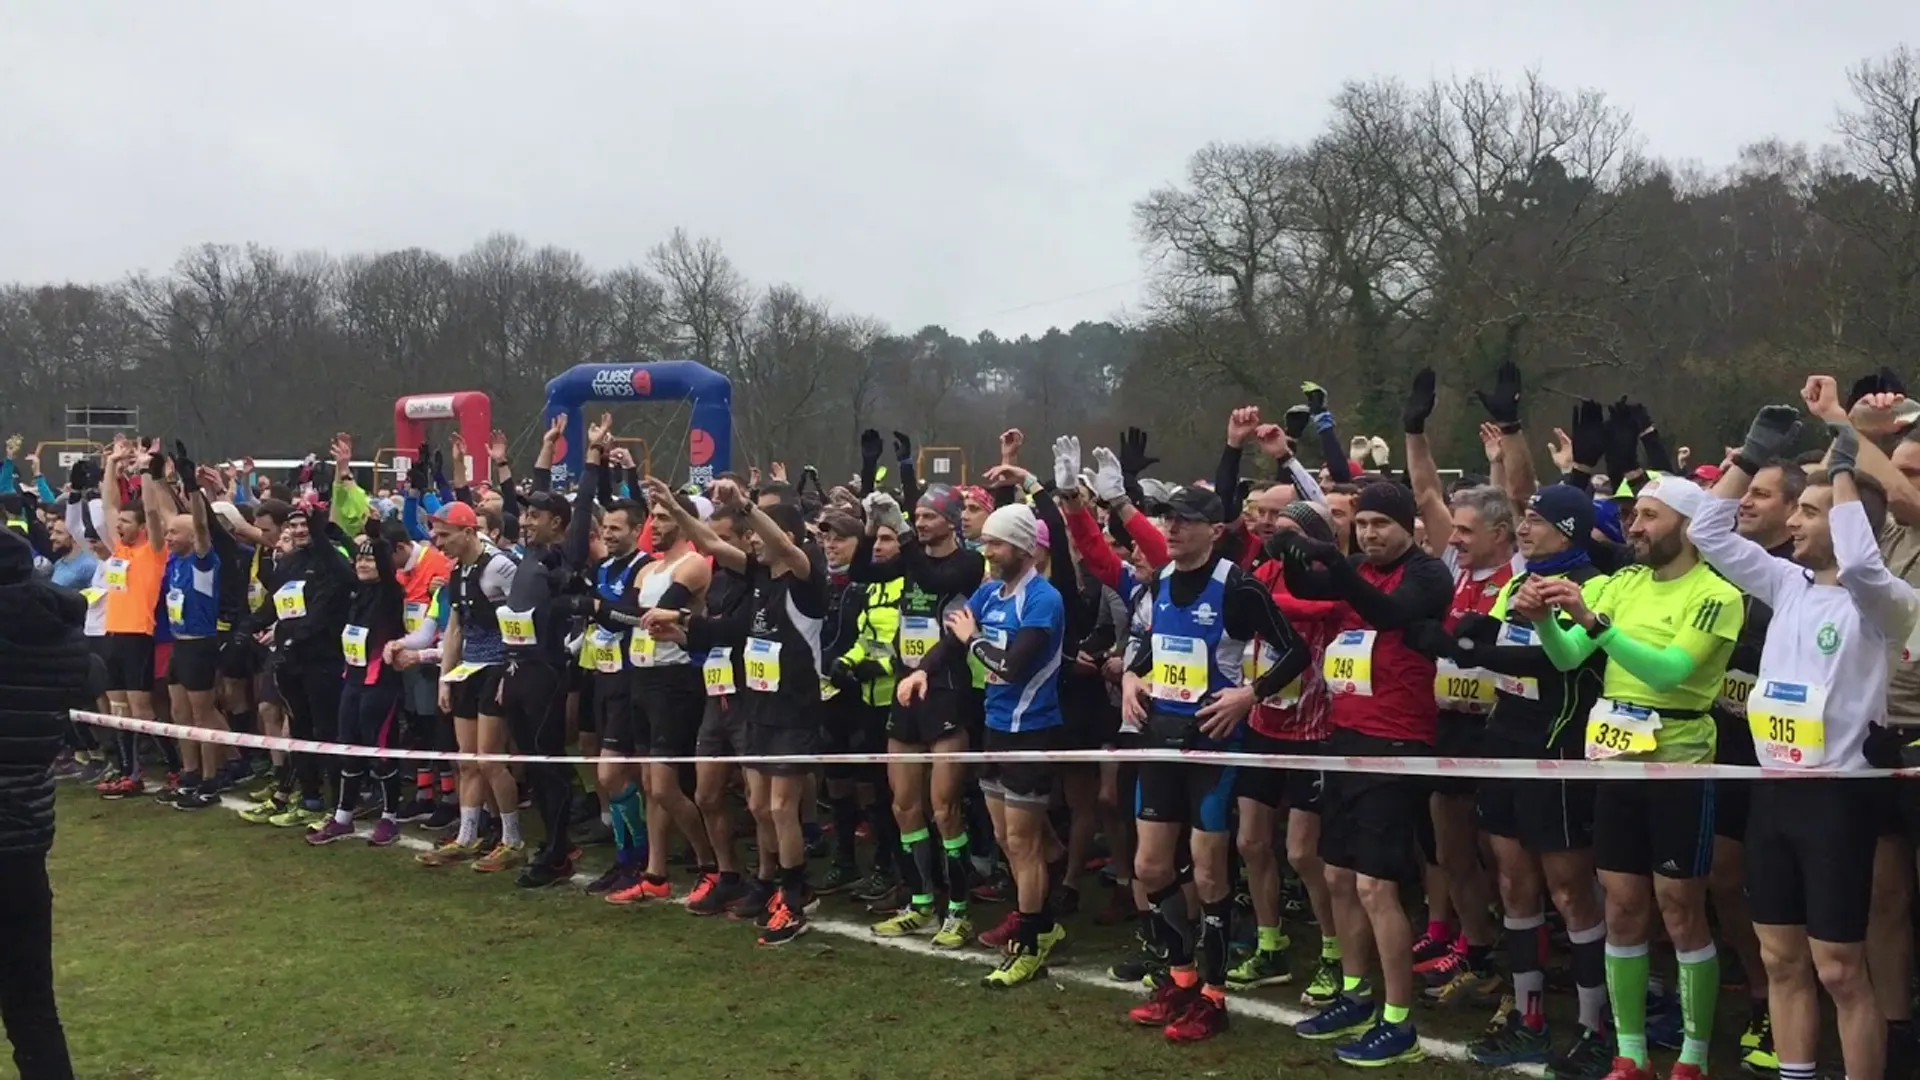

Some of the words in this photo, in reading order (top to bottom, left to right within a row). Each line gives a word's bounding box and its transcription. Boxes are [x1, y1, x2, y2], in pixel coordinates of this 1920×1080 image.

[595, 368, 634, 383] ouest
[591, 379, 635, 396] france
[1163, 664, 1186, 685] 764
[1333, 658, 1354, 678] 248
[1447, 677, 1479, 699] 1202
[1595, 723, 1633, 751] 335
[1769, 715, 1795, 743] 315
